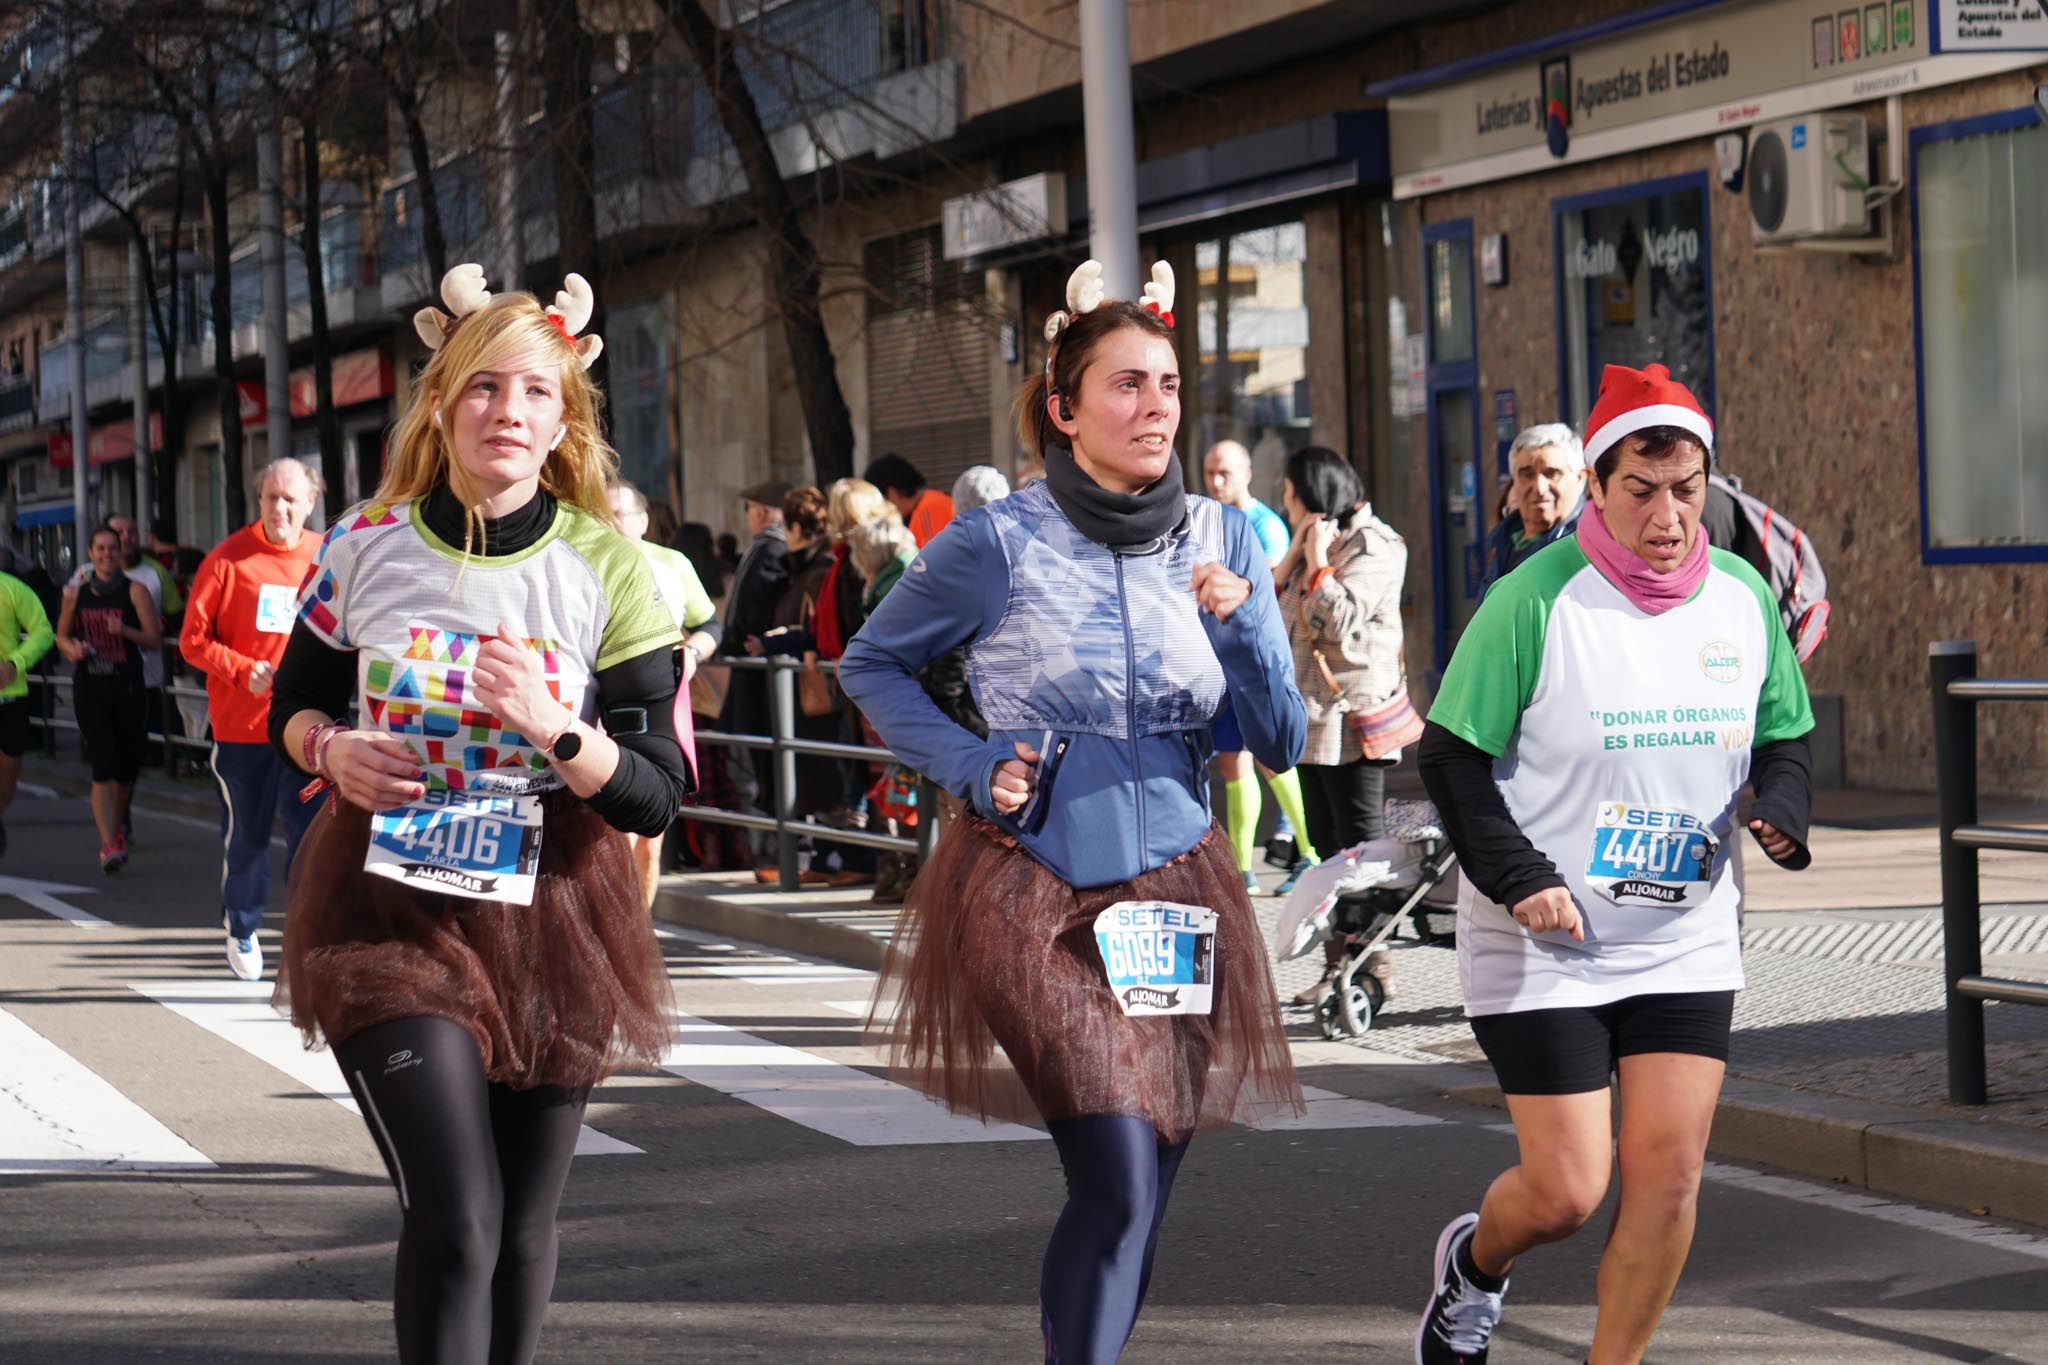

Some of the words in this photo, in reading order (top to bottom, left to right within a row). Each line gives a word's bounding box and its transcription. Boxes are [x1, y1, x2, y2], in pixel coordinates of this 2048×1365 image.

[1958, 10, 2017, 24] Apuestas
[2022, 7, 2041, 20] del
[1958, 25, 2003, 38] Estado
[1576, 66, 1642, 118] Apuestas
[1647, 52, 1670, 93] del
[1675, 40, 1729, 88] Estado
[1576, 237, 1616, 278] Gato
[1643, 225, 1699, 277] Negro
[1673, 704, 1747, 723] ÓRGANOS
[1604, 734, 1628, 750] ES
[1633, 730, 1716, 748] REGALAR
[424, 790, 529, 820] SETEL
[1627, 808, 1710, 836] SETEL
[392, 809, 502, 864] 4406
[1602, 829, 1689, 872] 4407
[414, 865, 483, 892] ALJOMAR
[1627, 870, 1661, 880] CONCHY
[1622, 883, 1675, 900] ALJOMAR
[1118, 908, 1200, 928] SETEL
[1106, 931, 1176, 978] 6099
[1129, 989, 1169, 1007] ALJOMAR
